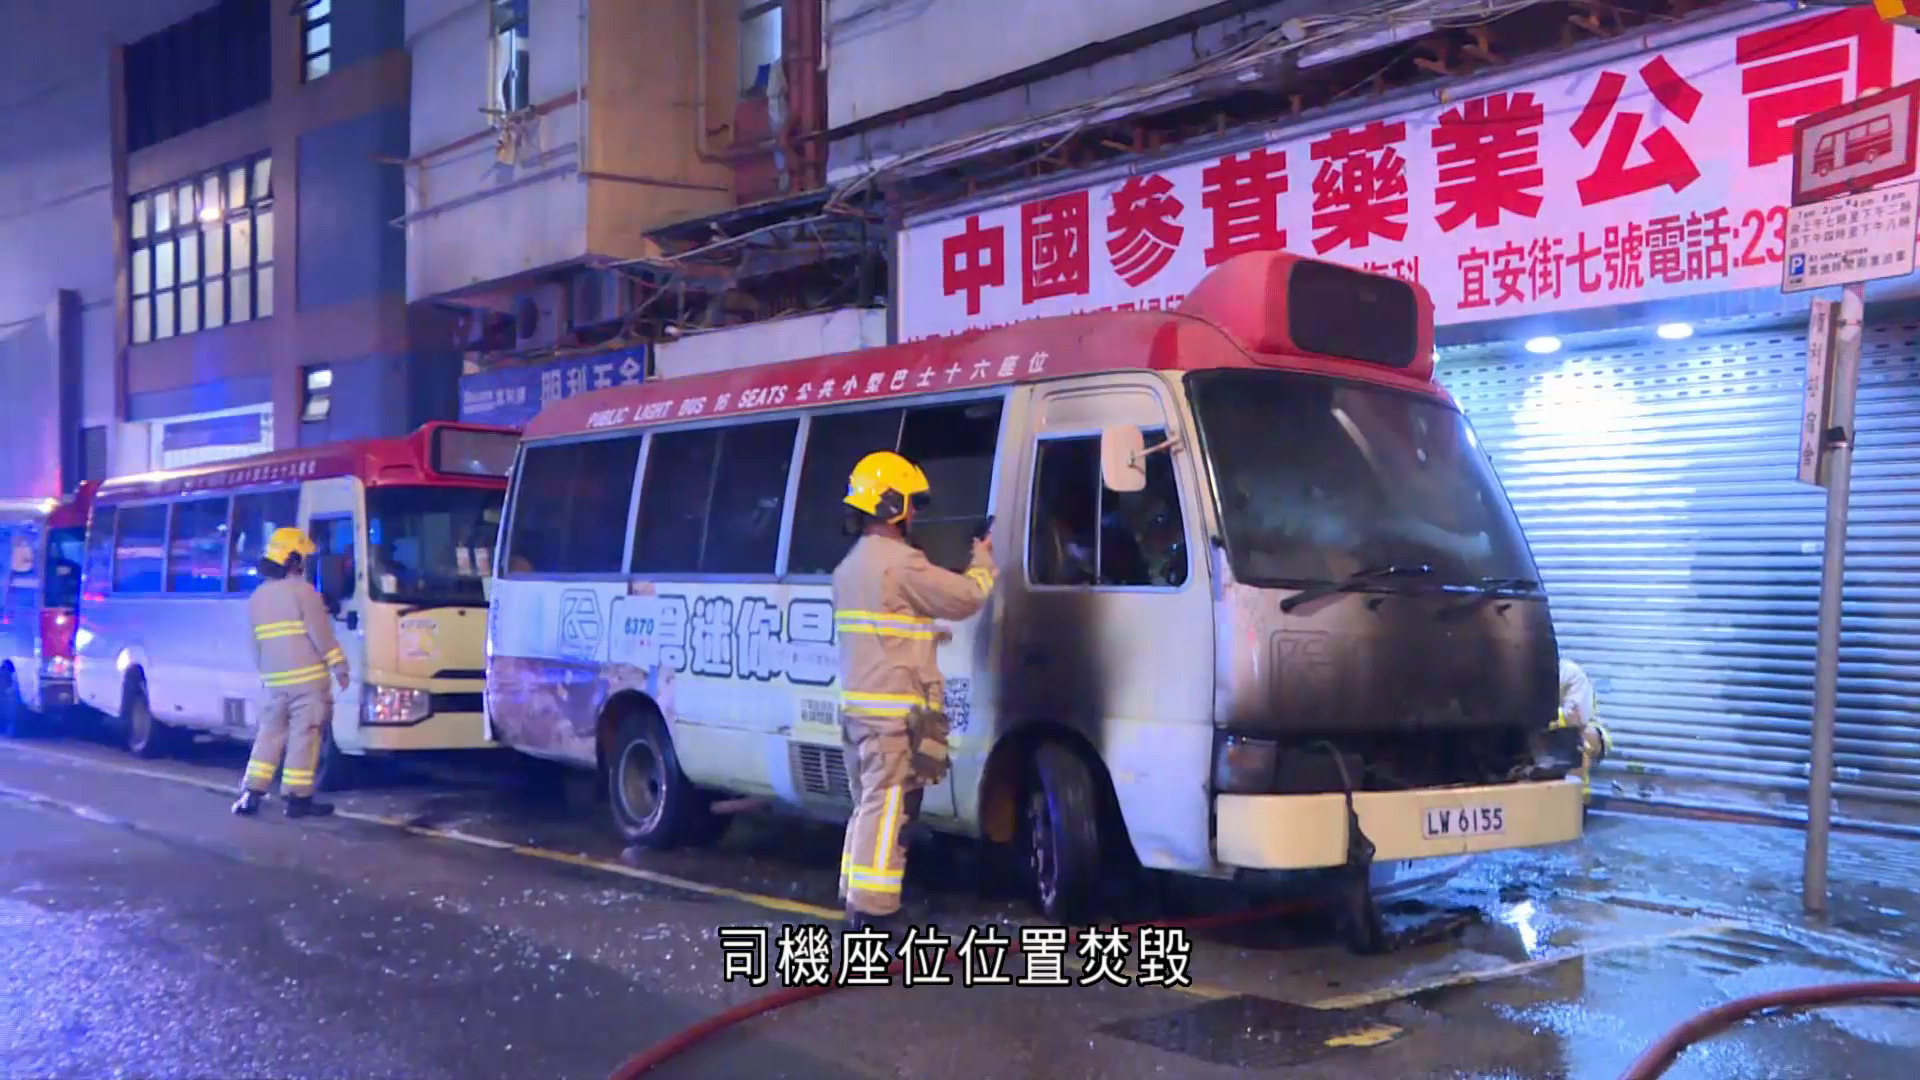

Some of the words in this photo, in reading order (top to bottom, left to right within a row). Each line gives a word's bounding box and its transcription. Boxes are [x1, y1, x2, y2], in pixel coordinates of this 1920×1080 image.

[942, 8, 1896, 314] 中國參茸藥業公司
[796, 351, 1049, 401] 公共小型巴士十六座位
[586, 406, 629, 429] PUBLIC
[633, 400, 673, 422] LIGHT
[678, 397, 707, 416] BUS
[714, 393, 731, 412] 16
[738, 384, 788, 409] SEATS
[1428, 810, 1450, 835] LW
[1458, 807, 1503, 833] 6155
